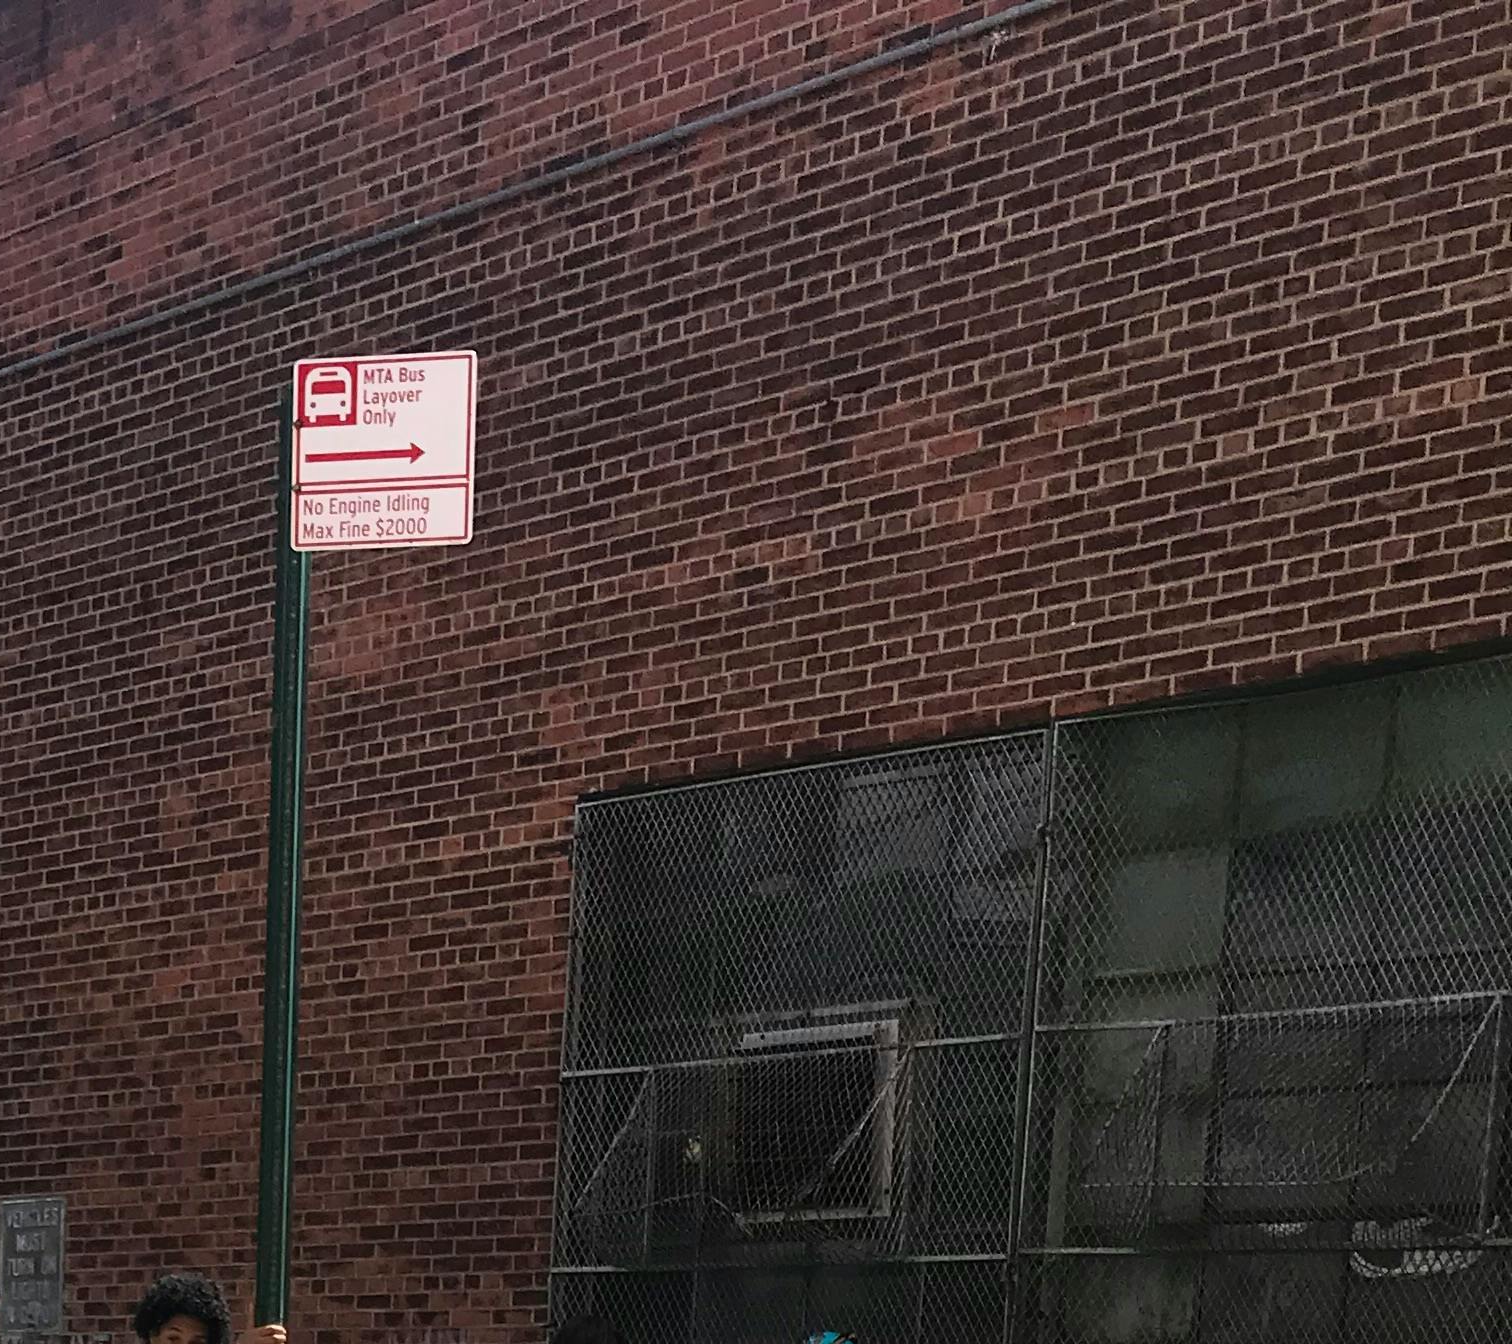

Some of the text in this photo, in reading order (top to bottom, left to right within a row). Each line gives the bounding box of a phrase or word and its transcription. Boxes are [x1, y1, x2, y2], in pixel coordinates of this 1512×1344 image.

[363, 367, 426, 385] MTA Bus
[363, 389, 423, 407] Layover
[363, 409, 397, 427] Only
[302, 494, 430, 518] No Engine Idling
[302, 517, 428, 539] Max Fine $2000
